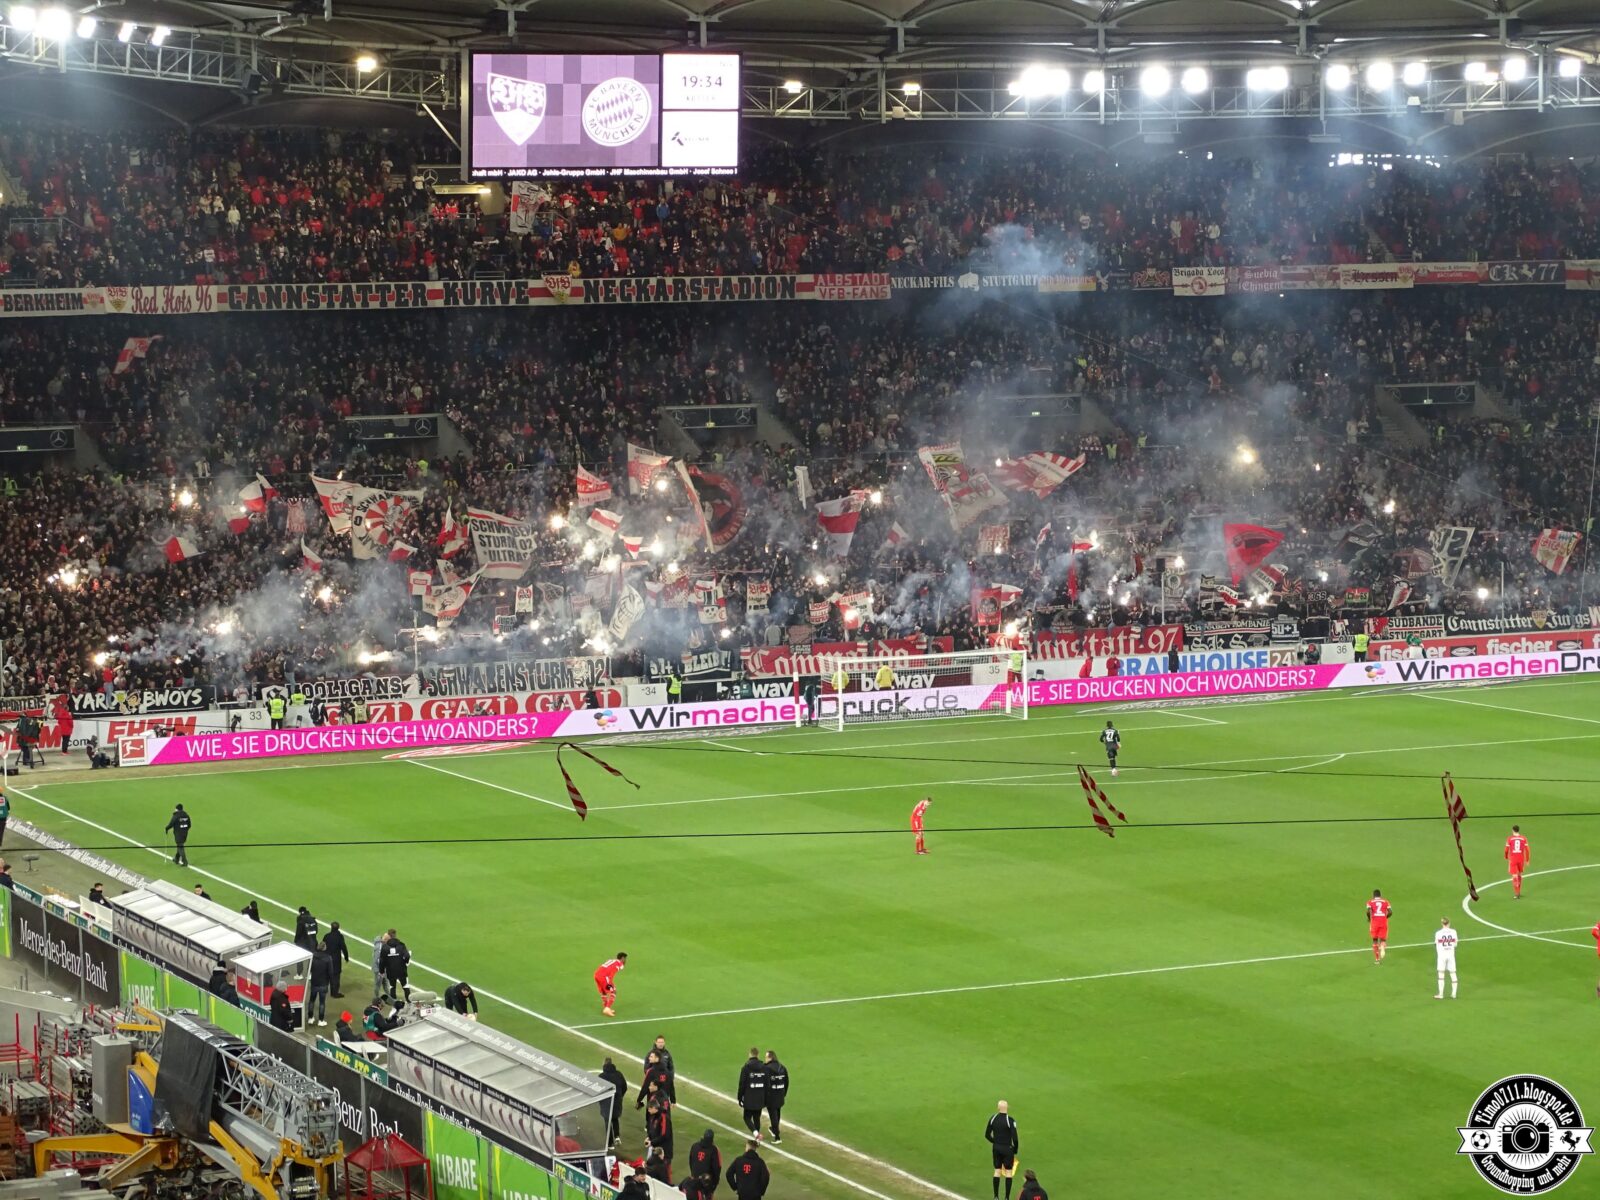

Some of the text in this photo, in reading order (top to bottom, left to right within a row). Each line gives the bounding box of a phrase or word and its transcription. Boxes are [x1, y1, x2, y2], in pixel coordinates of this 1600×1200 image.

[682, 75, 722, 88] 19:34
[817, 273, 890, 286] ALBSTADT
[1538, 263, 1559, 280] 77
[583, 276, 797, 304] NECKARSTADION
[891, 275, 955, 289] NECKAR-FILS
[982, 274, 1037, 287] STUTTGART
[3, 292, 84, 313] BERKHEIM
[131, 284, 212, 314] Red Hots 96
[228, 281, 530, 311] CANNSTATTER KURVE
[819, 287, 889, 300] VFB-FANS
[478, 534, 534, 551] STURM 02
[1147, 626, 1179, 654] 97
[1486, 637, 1553, 655] fischer
[1337, 646, 1348, 654] 36
[1380, 645, 1447, 661] fiscer
[989, 665, 1000, 674] 35
[1396, 652, 1600, 682] WirmachenDr
[285, 676, 402, 699] HOOLIGANS
[717, 680, 793, 701] beway
[861, 673, 935, 692] beway
[1050, 683, 1073, 701] SIE
[1077, 679, 1156, 699] DRUCKEN
[1160, 676, 1209, 694] NOCH
[1213, 669, 1316, 690] WOANDERS?
[143, 688, 203, 707] BWOYS
[250, 711, 262, 720] 33
[325, 702, 402, 727] GZI
[186, 717, 538, 758] WIE, SIE DRUCKEN NOCH WOANDERS?
[1514, 840, 1521, 850] 8
[1375, 902, 1383, 914] 2
[1441, 935, 1453, 947] 22
[20, 917, 82, 978] Mercedes-Benz
[85, 952, 108, 993] Bank
[436, 1153, 478, 1190] LIBARE
